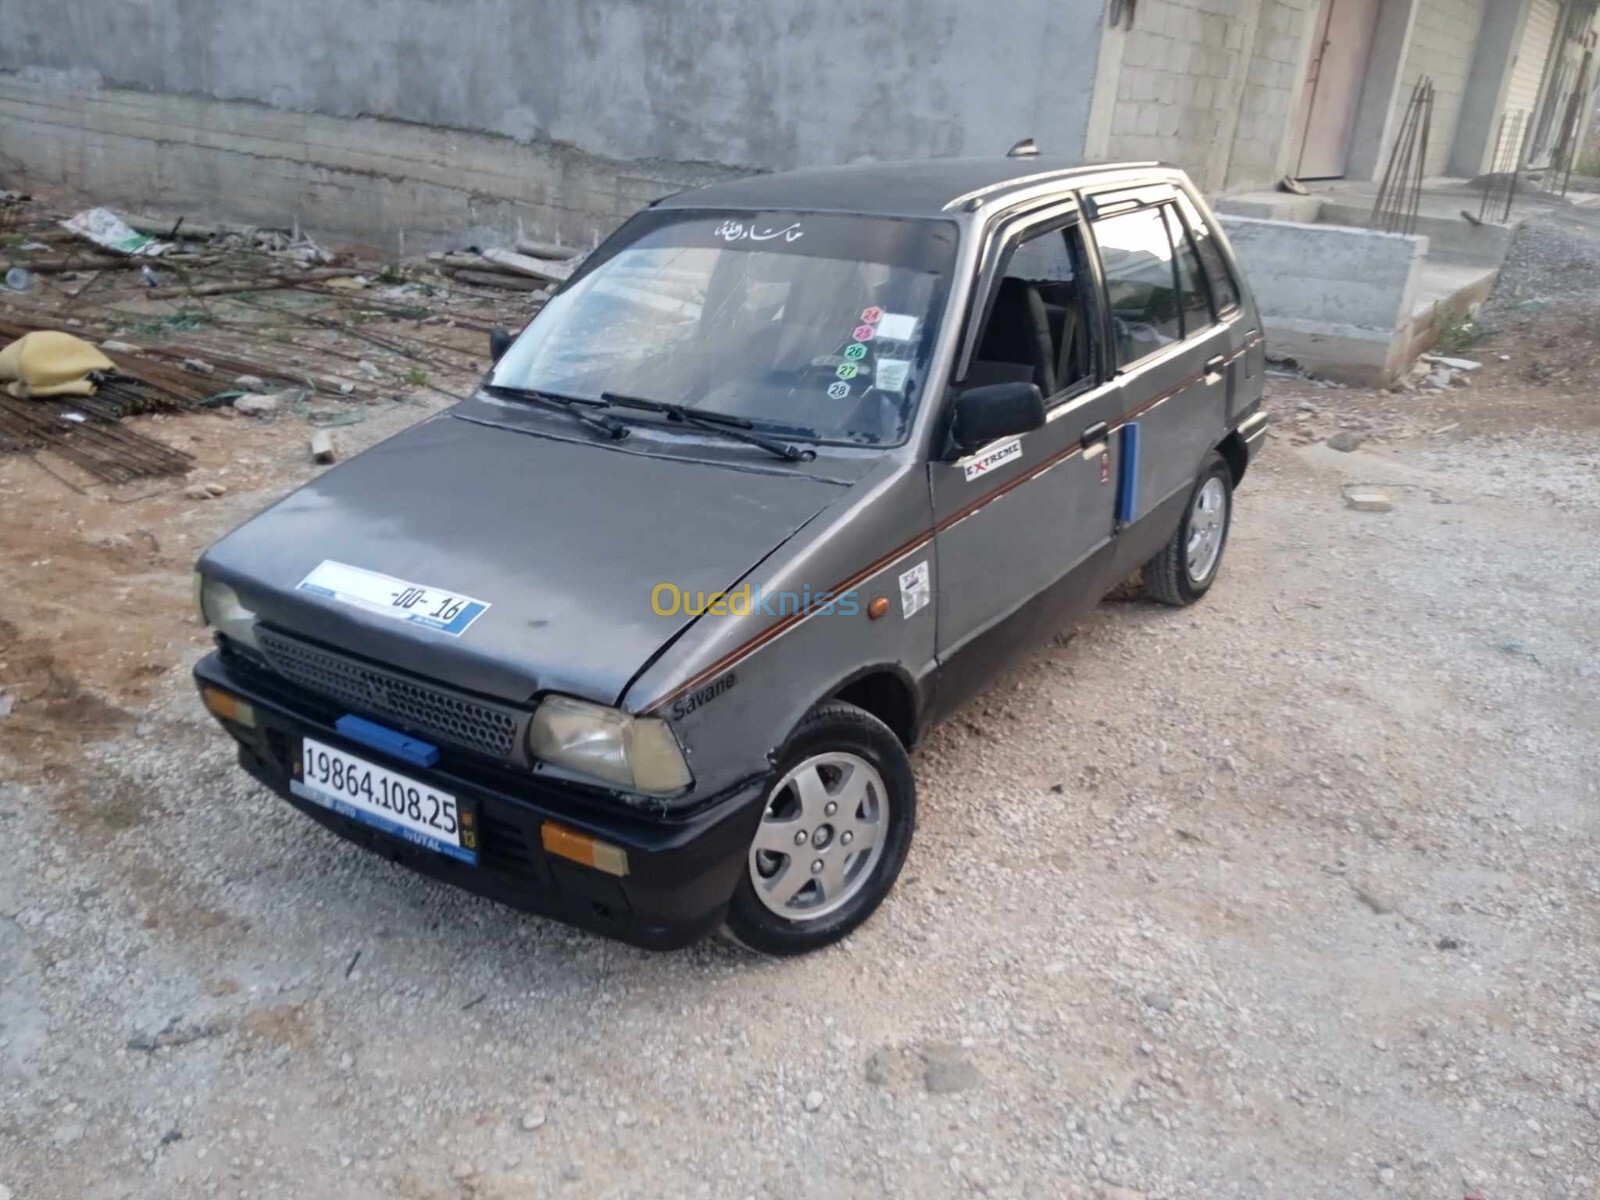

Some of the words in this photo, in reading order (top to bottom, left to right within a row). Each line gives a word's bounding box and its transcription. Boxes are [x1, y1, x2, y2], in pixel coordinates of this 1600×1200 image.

[847, 346, 863, 358] 26
[838, 365, 855, 377] 27
[830, 384, 846, 397] 28
[966, 443, 1020, 476] EXTREME
[672, 671, 736, 722] Savane
[305, 747, 458, 834] 19864.108.25
